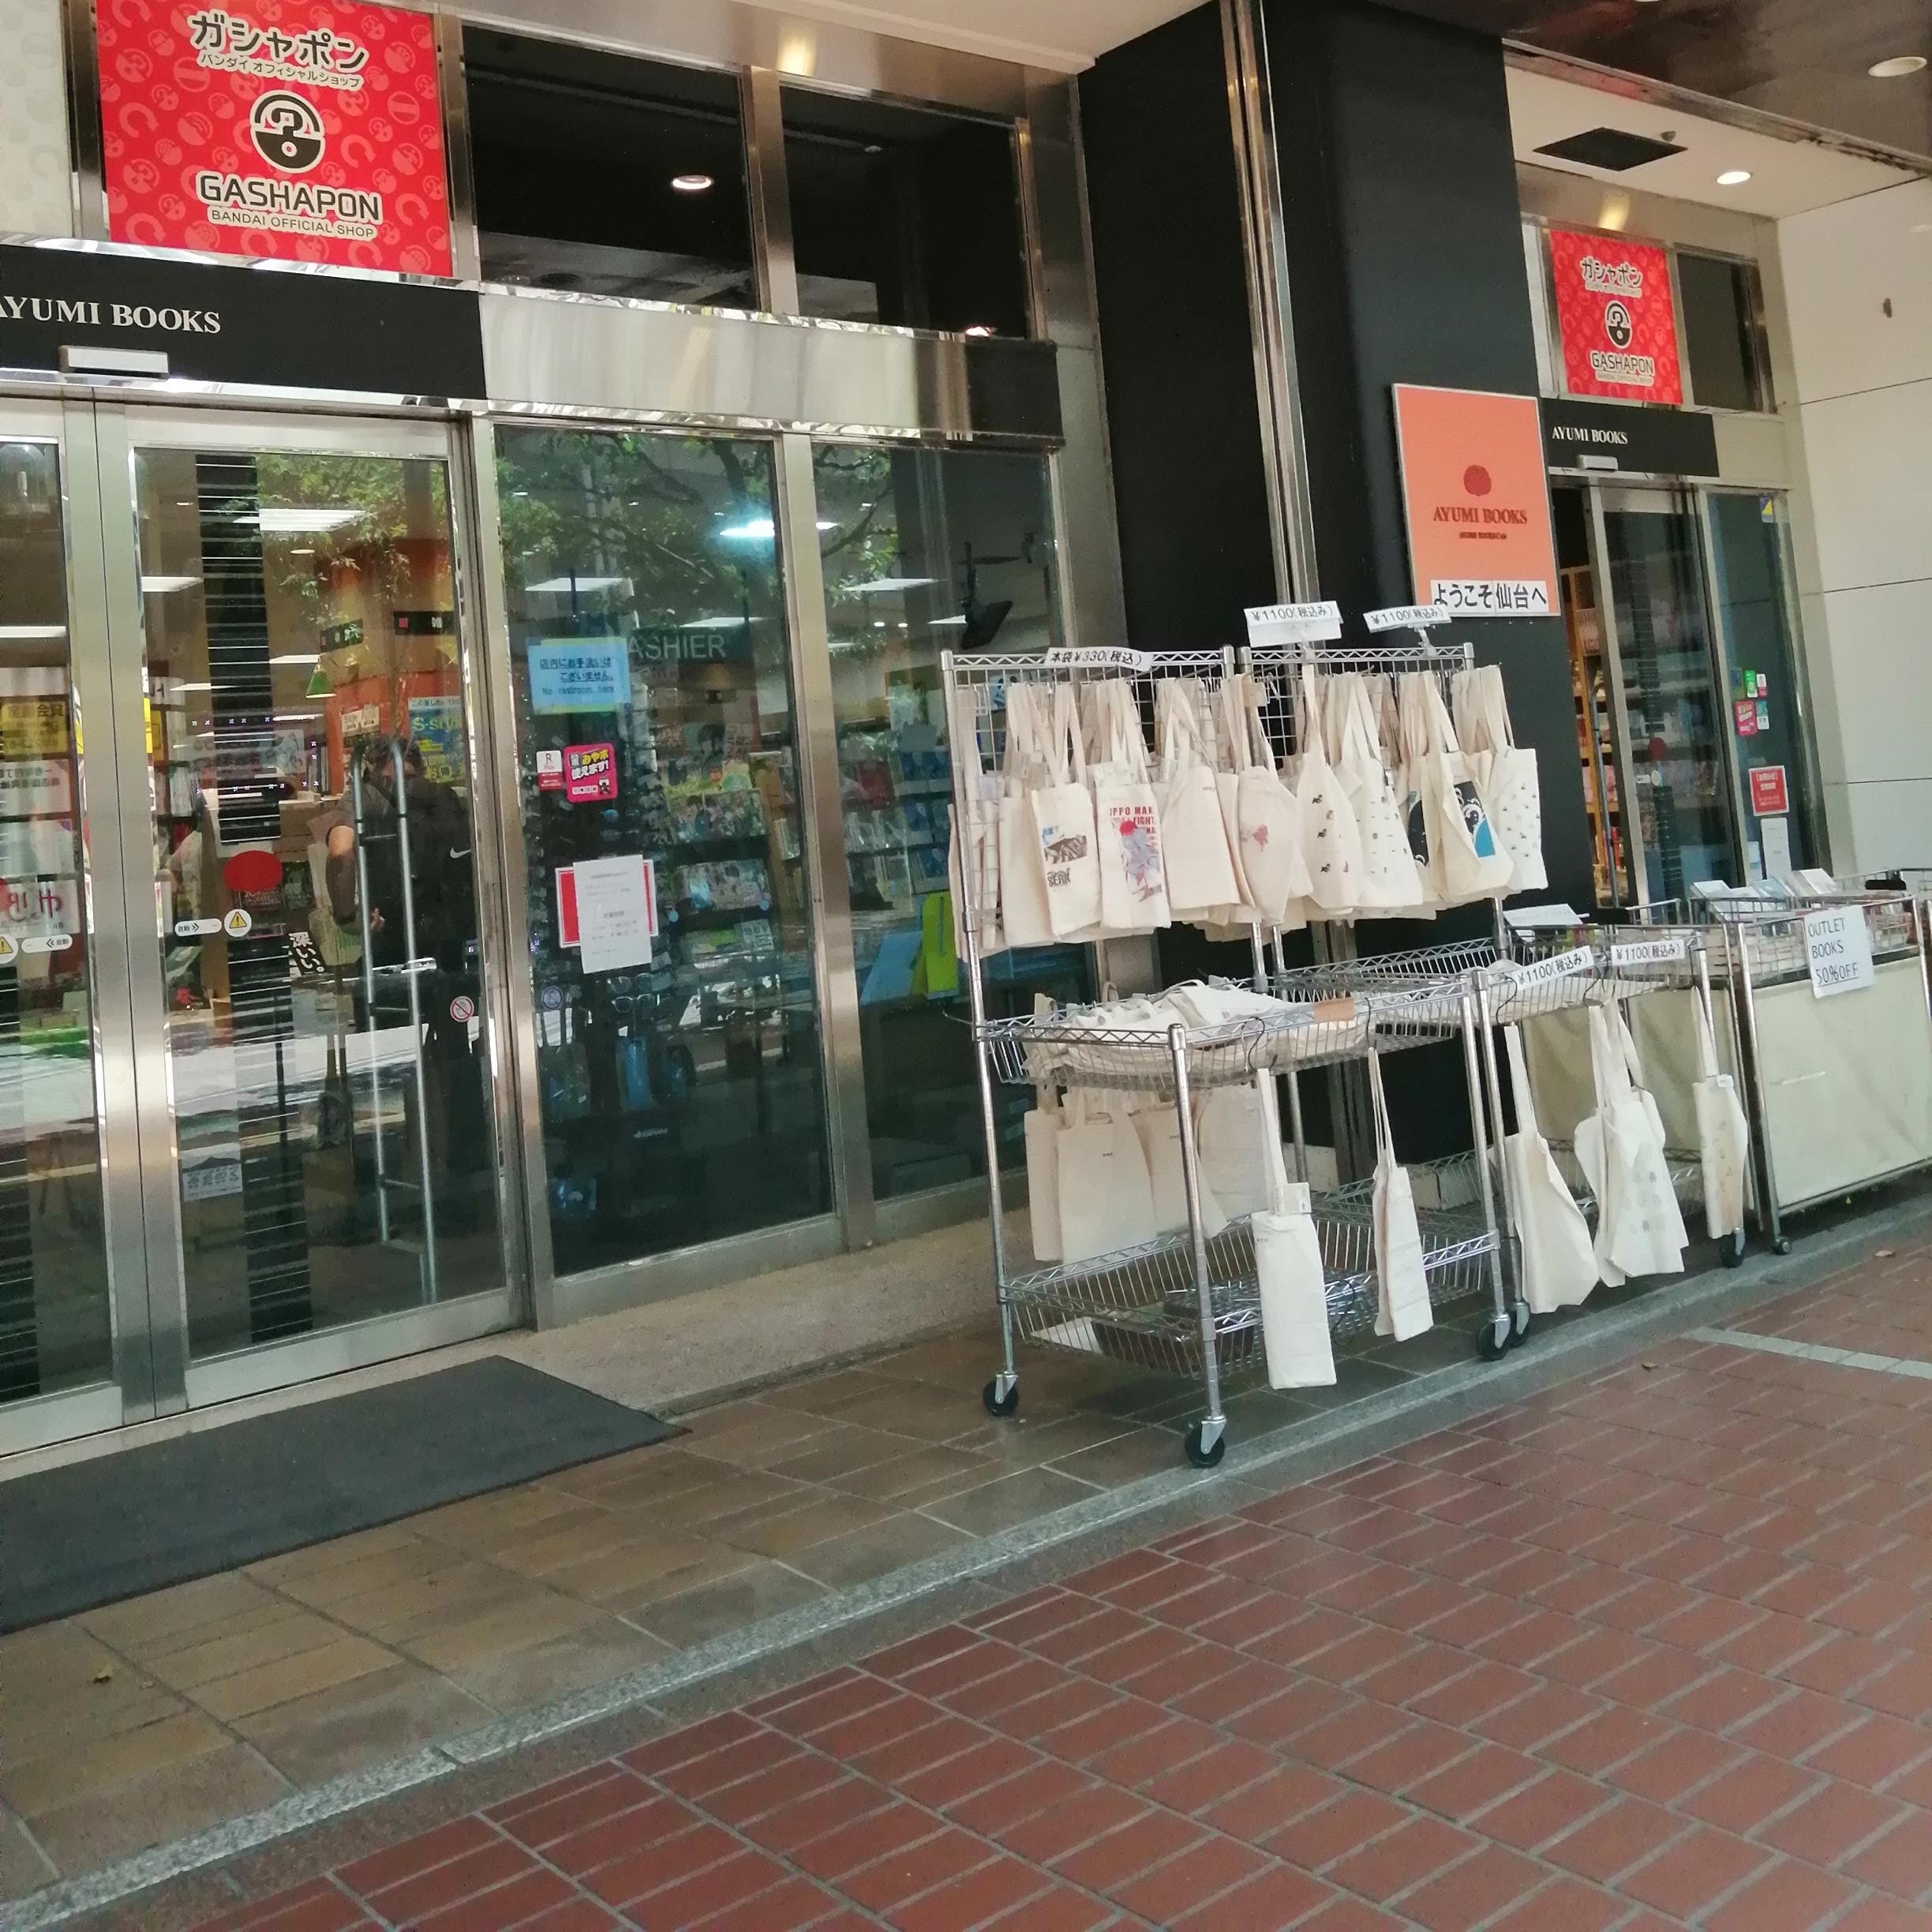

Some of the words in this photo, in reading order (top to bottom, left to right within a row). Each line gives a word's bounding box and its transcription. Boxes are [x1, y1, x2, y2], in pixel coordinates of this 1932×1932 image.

[192, 13, 365, 69] ガシャポン
[201, 54, 249, 69] バンダイ
[253, 62, 360, 88] オフィシャルショップ
[200, 174, 380, 220] GASHAPON
[212, 210, 265, 226] BANDAI
[271, 218, 332, 233] OFFICIAL
[337, 225, 374, 237] SHOP
[1582, 258, 1642, 285] ガシャポン
[110, 303, 221, 334] BOOKS
[1592, 352, 1653, 373] GASHAPON
[1552, 426, 1589, 442] AYUMI
[1590, 429, 1628, 444] BOOKS
[1433, 507, 1480, 523] AYUMI
[1482, 508, 1528, 525] BOOKS
[1434, 582, 1547, 608] ようこそ仙台へ
[628, 634, 727, 659] ASHIER
[1807, 917, 1845, 938] OUTLET
[1811, 939, 1844, 959] BOOKS
[1815, 962, 1859, 985] 50%OFF
